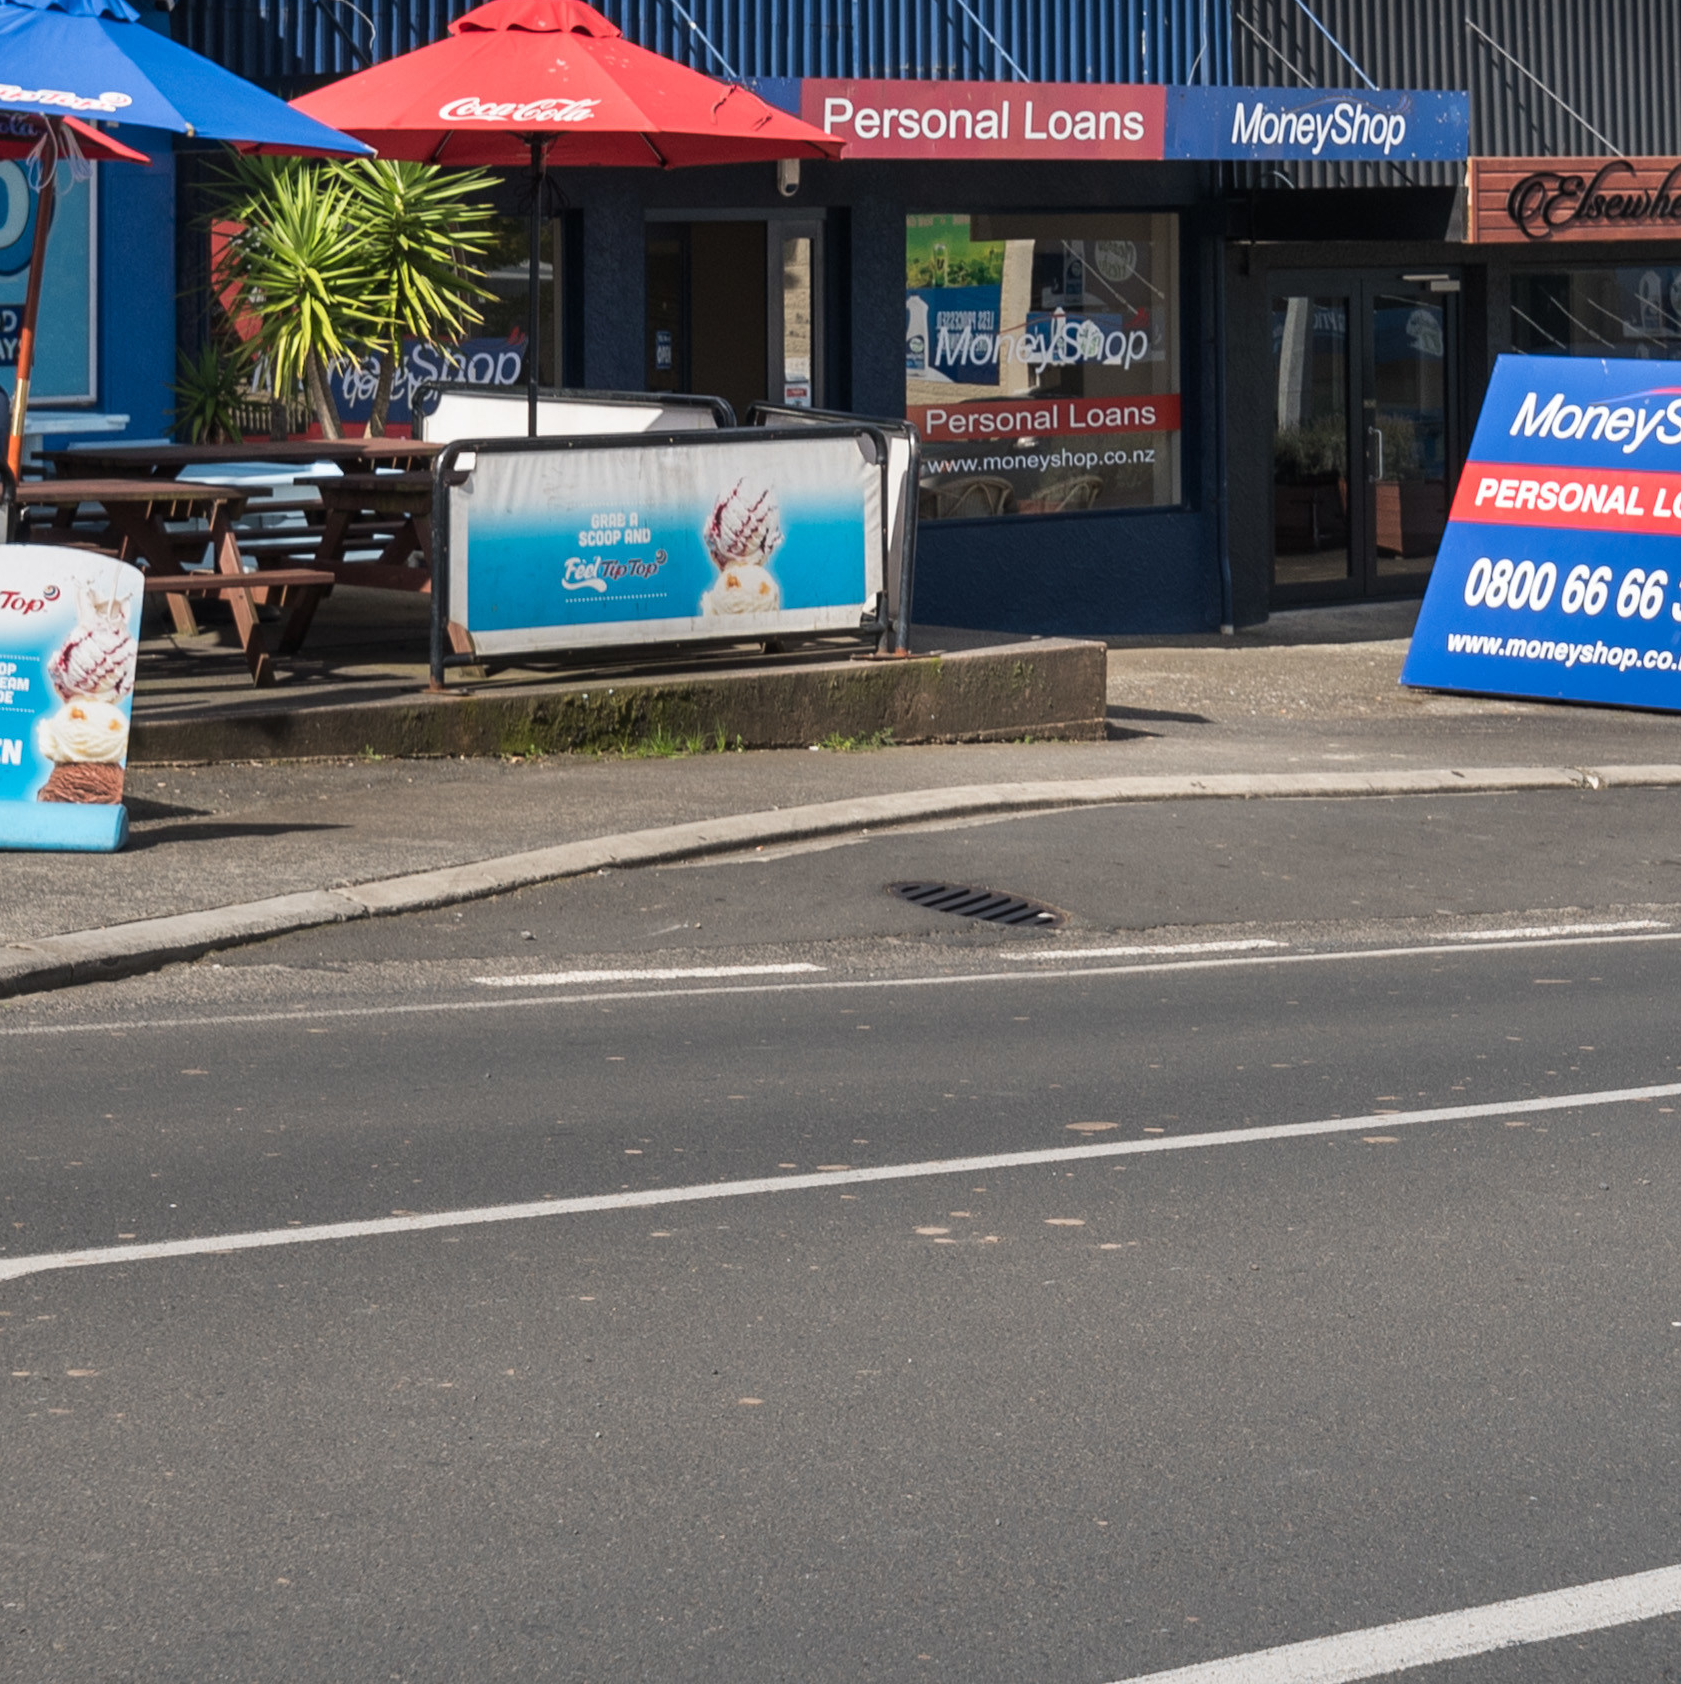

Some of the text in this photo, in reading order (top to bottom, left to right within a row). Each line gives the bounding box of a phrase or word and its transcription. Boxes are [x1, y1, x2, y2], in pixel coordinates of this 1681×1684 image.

[823, 98, 1146, 141] Personal Loans
[1231, 102, 1407, 155] MoneyShop
[933, 321, 1149, 375] MoneyShop
[925, 403, 1157, 435] Personal Loans
[926, 447, 1156, 475] www.moneyshop.co.nz
[1474, 478, 1645, 517] PERSONAL
[591, 511, 639, 530] GRAB A
[578, 527, 651, 548] SCOOP AND
[600, 559, 628, 581] Tip
[627, 558, 658, 580] Top
[0, 589, 46, 616] Top
[1463, 556, 1557, 612] 0800
[1561, 564, 1613, 616] 66
[1616, 567, 1668, 620] 66
